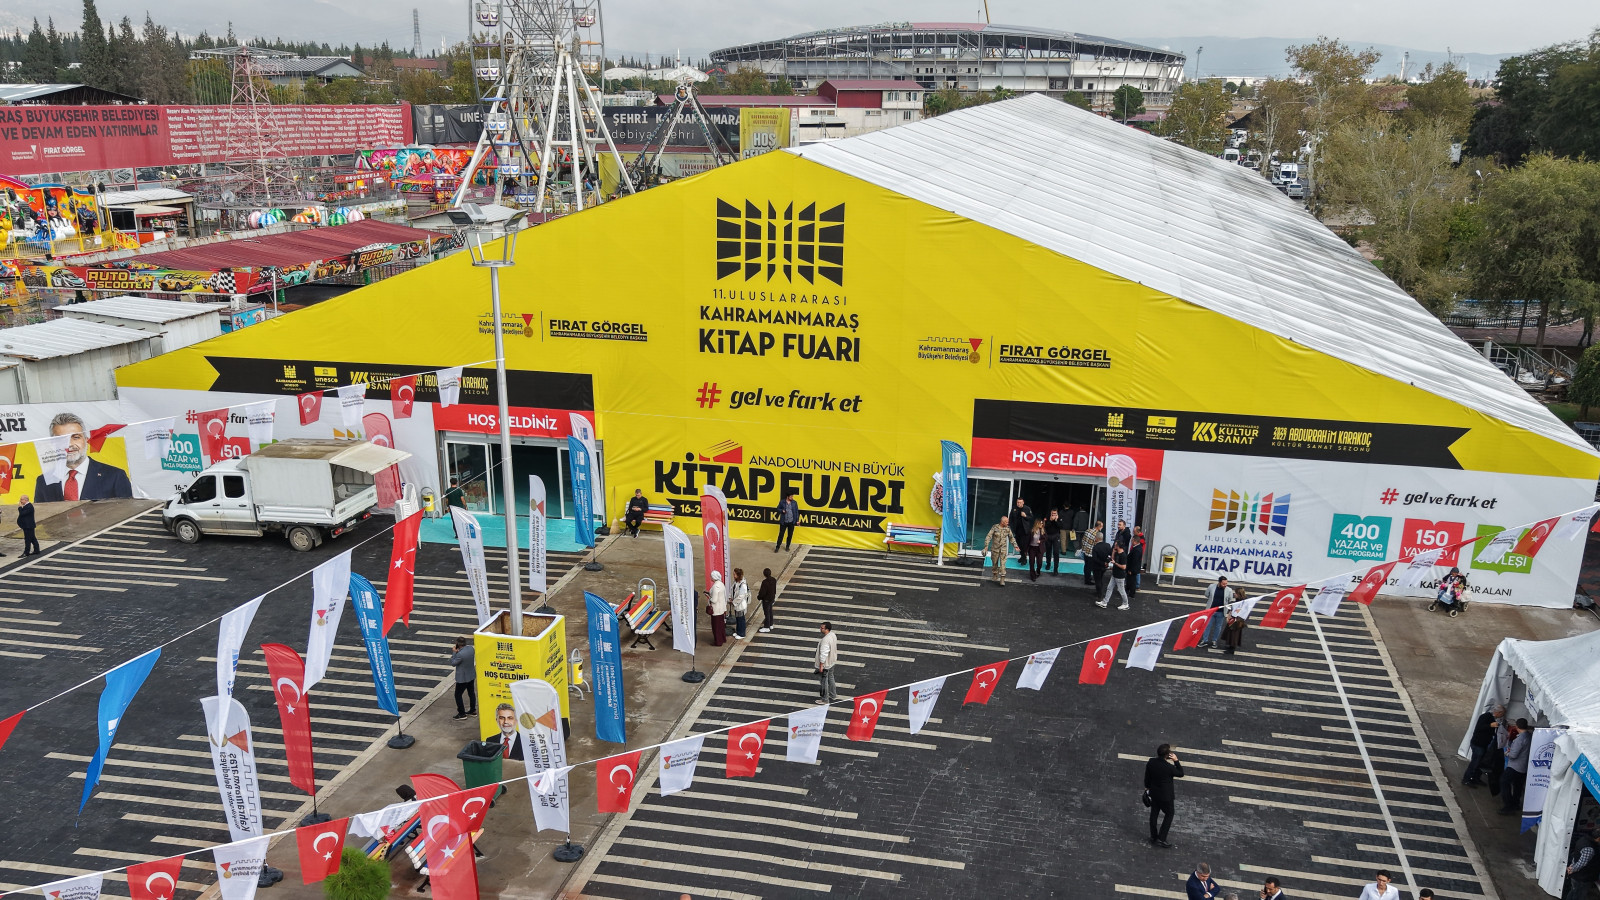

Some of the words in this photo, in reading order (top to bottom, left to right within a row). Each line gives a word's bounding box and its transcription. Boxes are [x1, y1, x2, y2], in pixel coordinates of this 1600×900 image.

[26, 109, 99, 124] BÜYÜKŞEHİR
[102, 109, 159, 122] BELEDİYESİ
[613, 111, 648, 126] ŞEHRİ
[1, 128, 19, 140] VE
[22, 126, 63, 140] DEVAM
[66, 125, 97, 138] EDEN
[99, 124, 158, 138] YATIRIMLAR
[62, 145, 85, 153] GÖRGEL
[753, 133, 776, 149] HOŞ
[361, 250, 382, 261] AUTO
[88, 271, 128, 280] AUTO
[550, 319, 587, 331] FIRAT
[592, 320, 647, 334] GÖRGEL
[700, 305, 859, 333] KAHRAMANMARAŞ
[700, 328, 775, 356] KİTAP
[783, 333, 860, 362] FUARI
[919, 345, 969, 354] Kahramanmaraş
[1000, 344, 1043, 357] FIRAT
[1048, 346, 1111, 360] GÖRGEL
[918, 352, 943, 360] Büyükşehir
[944, 353, 969, 361] Belediyesi
[462, 377, 489, 390] KARAKOÇ
[730, 387, 763, 409] gel
[765, 394, 784, 407] ve
[788, 389, 836, 411] fark
[840, 394, 862, 412] et
[230, 413, 247, 424] far
[468, 413, 496, 429] HOŞ
[499, 414, 557, 430] ELDİNİZ
[1218, 435, 1254, 444] SANAT
[1289, 428, 1337, 444] ABDURRAHİM
[1338, 430, 1372, 447] KARAKOÇ
[169, 440, 193, 454] 400
[749, 455, 842, 473] ANADOLU'NUN
[844, 462, 860, 473] EN
[863, 461, 905, 477] BÜYÜK
[1012, 450, 1045, 467] HOŞ
[654, 452, 775, 500] KİTAP
[780, 471, 905, 514] FUARI
[1403, 491, 1429, 505] gel
[1429, 495, 1443, 505] ve
[1445, 493, 1478, 508] fark
[1480, 497, 1497, 509] et
[680, 504, 700, 514] 16-2
[738, 509, 762, 519] 2026
[810, 514, 837, 525] FUAR
[840, 516, 872, 529] ALANI
[1341, 523, 1380, 540] 400
[1416, 529, 1449, 547] 150
[1195, 544, 1293, 561] KAHRAMANMARAŞ
[1334, 539, 1368, 550] YAZAR
[1348, 550, 1384, 558] PROGRAMI
[1193, 556, 1240, 572] KİTAP
[1244, 561, 1292, 577] FUARI
[1482, 588, 1512, 596] ALANI
[484, 671, 498, 680] HOŞ
[500, 672, 530, 680] GELDİNİZ
